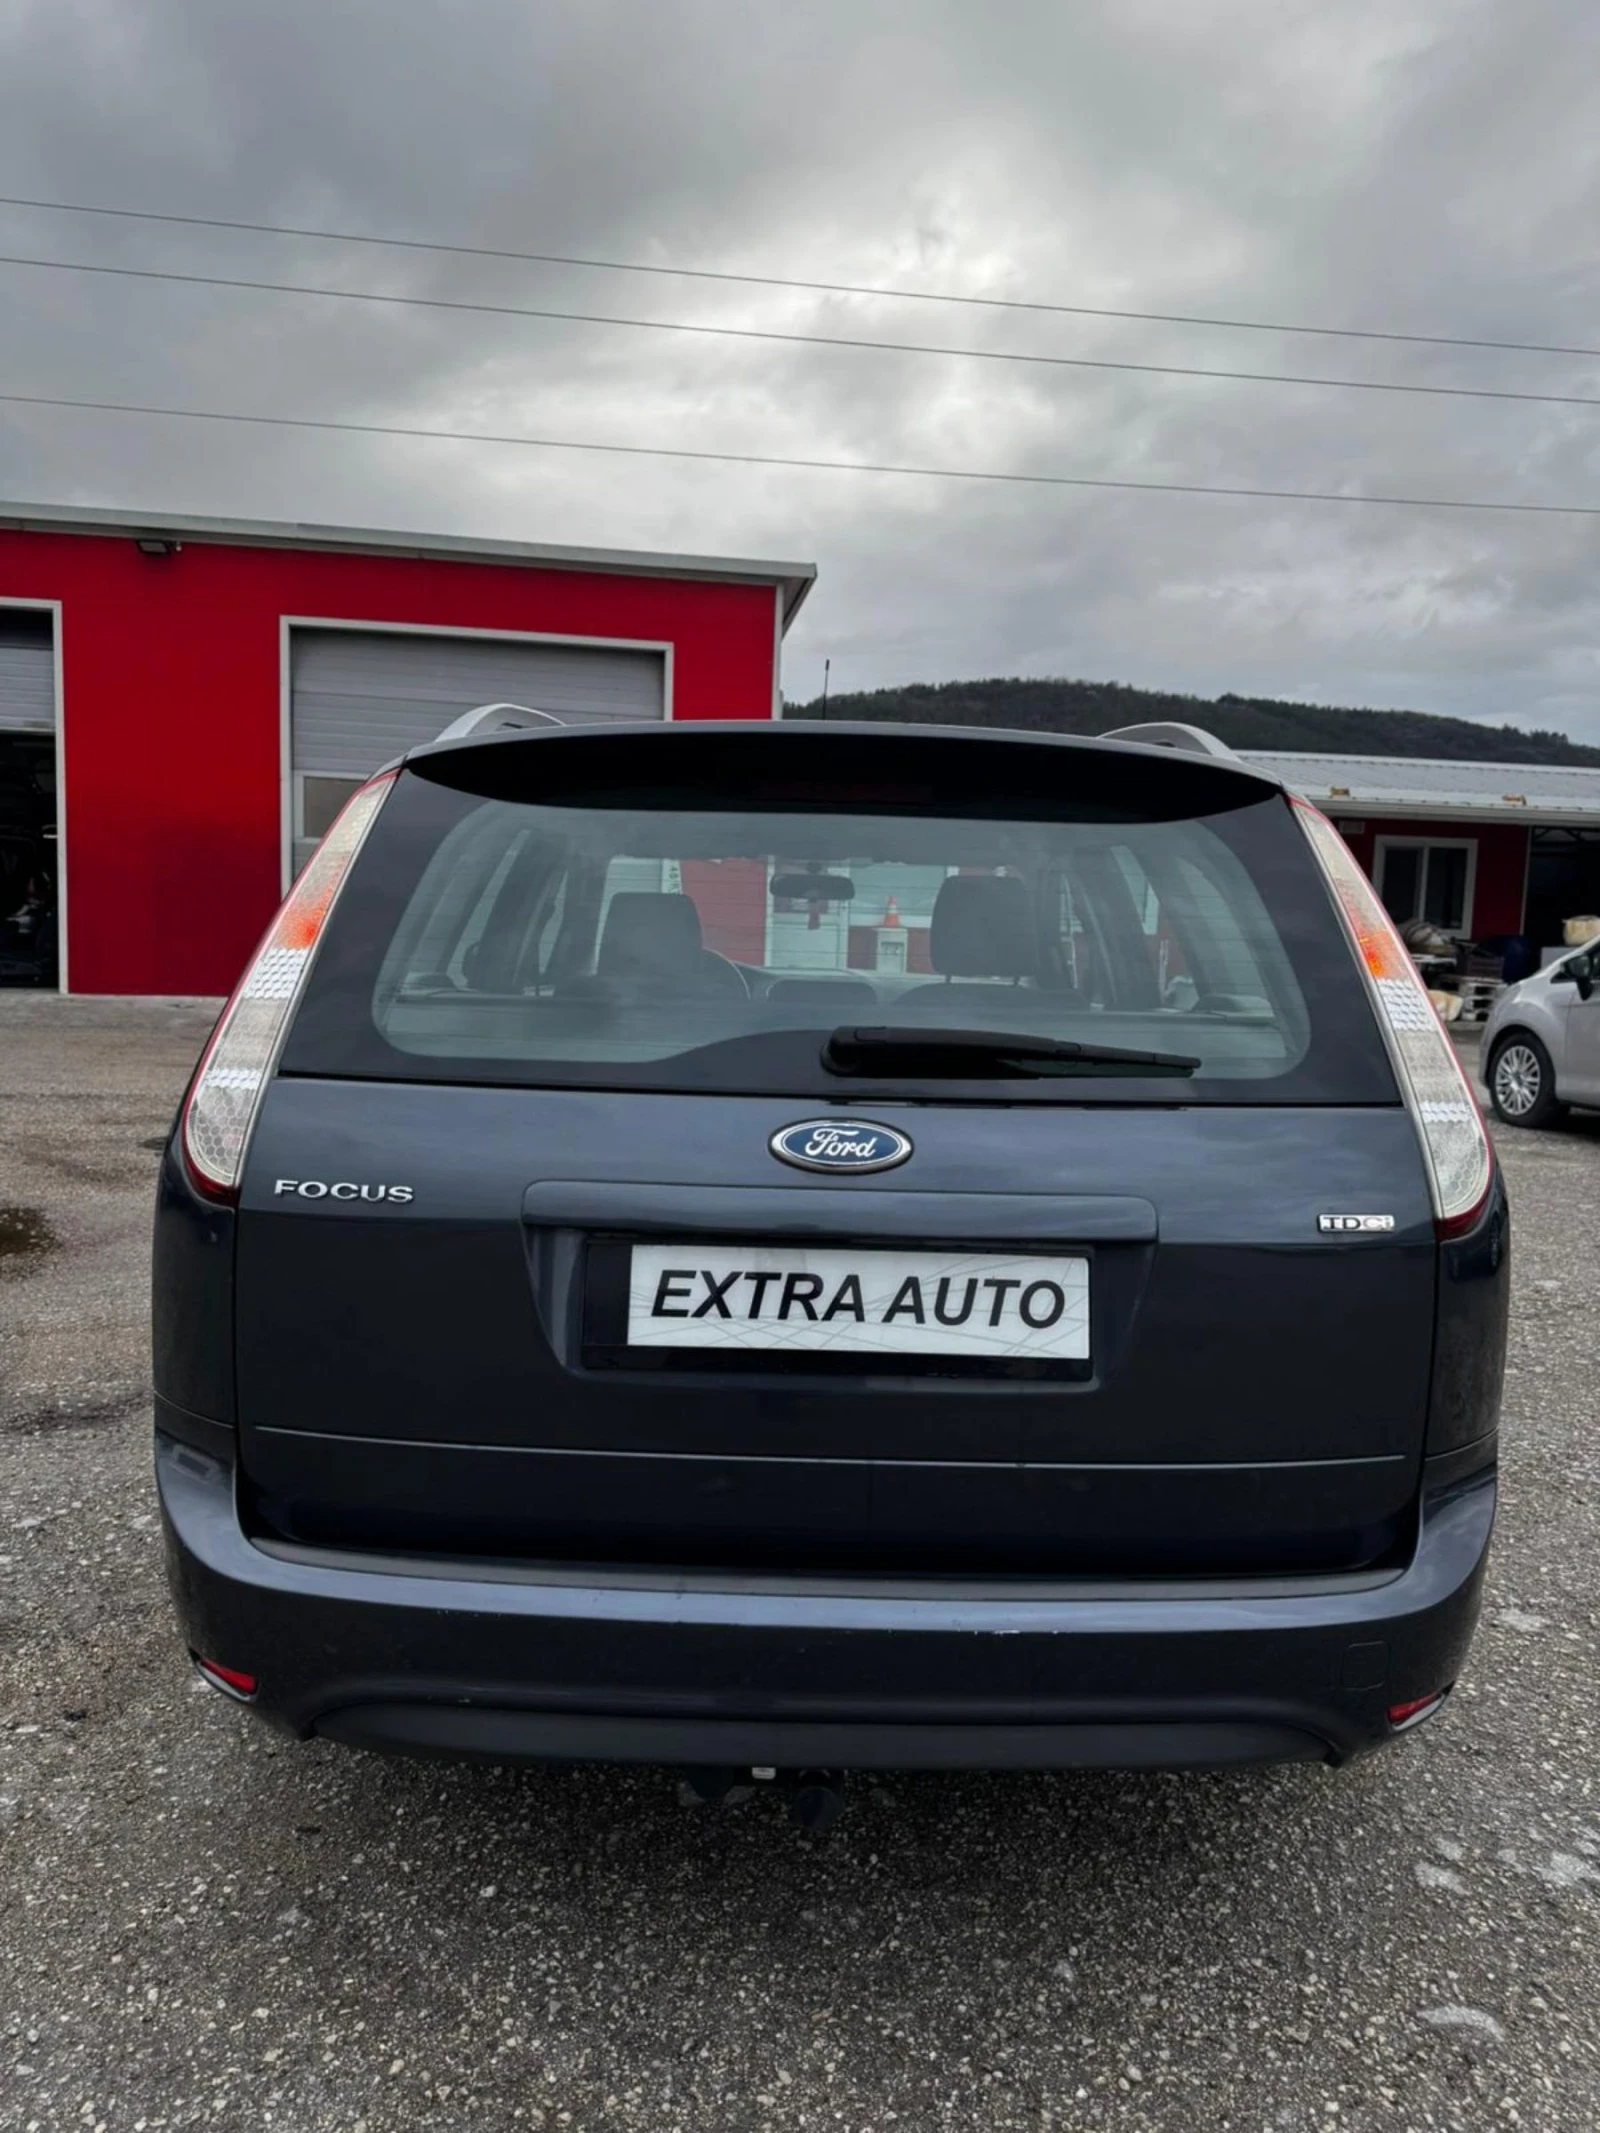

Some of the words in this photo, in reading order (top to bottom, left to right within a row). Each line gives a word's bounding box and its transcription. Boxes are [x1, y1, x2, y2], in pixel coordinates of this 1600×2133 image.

[804, 1127, 879, 1157] Ford
[274, 1179, 414, 1203] FOCUS
[650, 1269, 866, 1322] EXTRA
[882, 1276, 1066, 1329] AUTO
